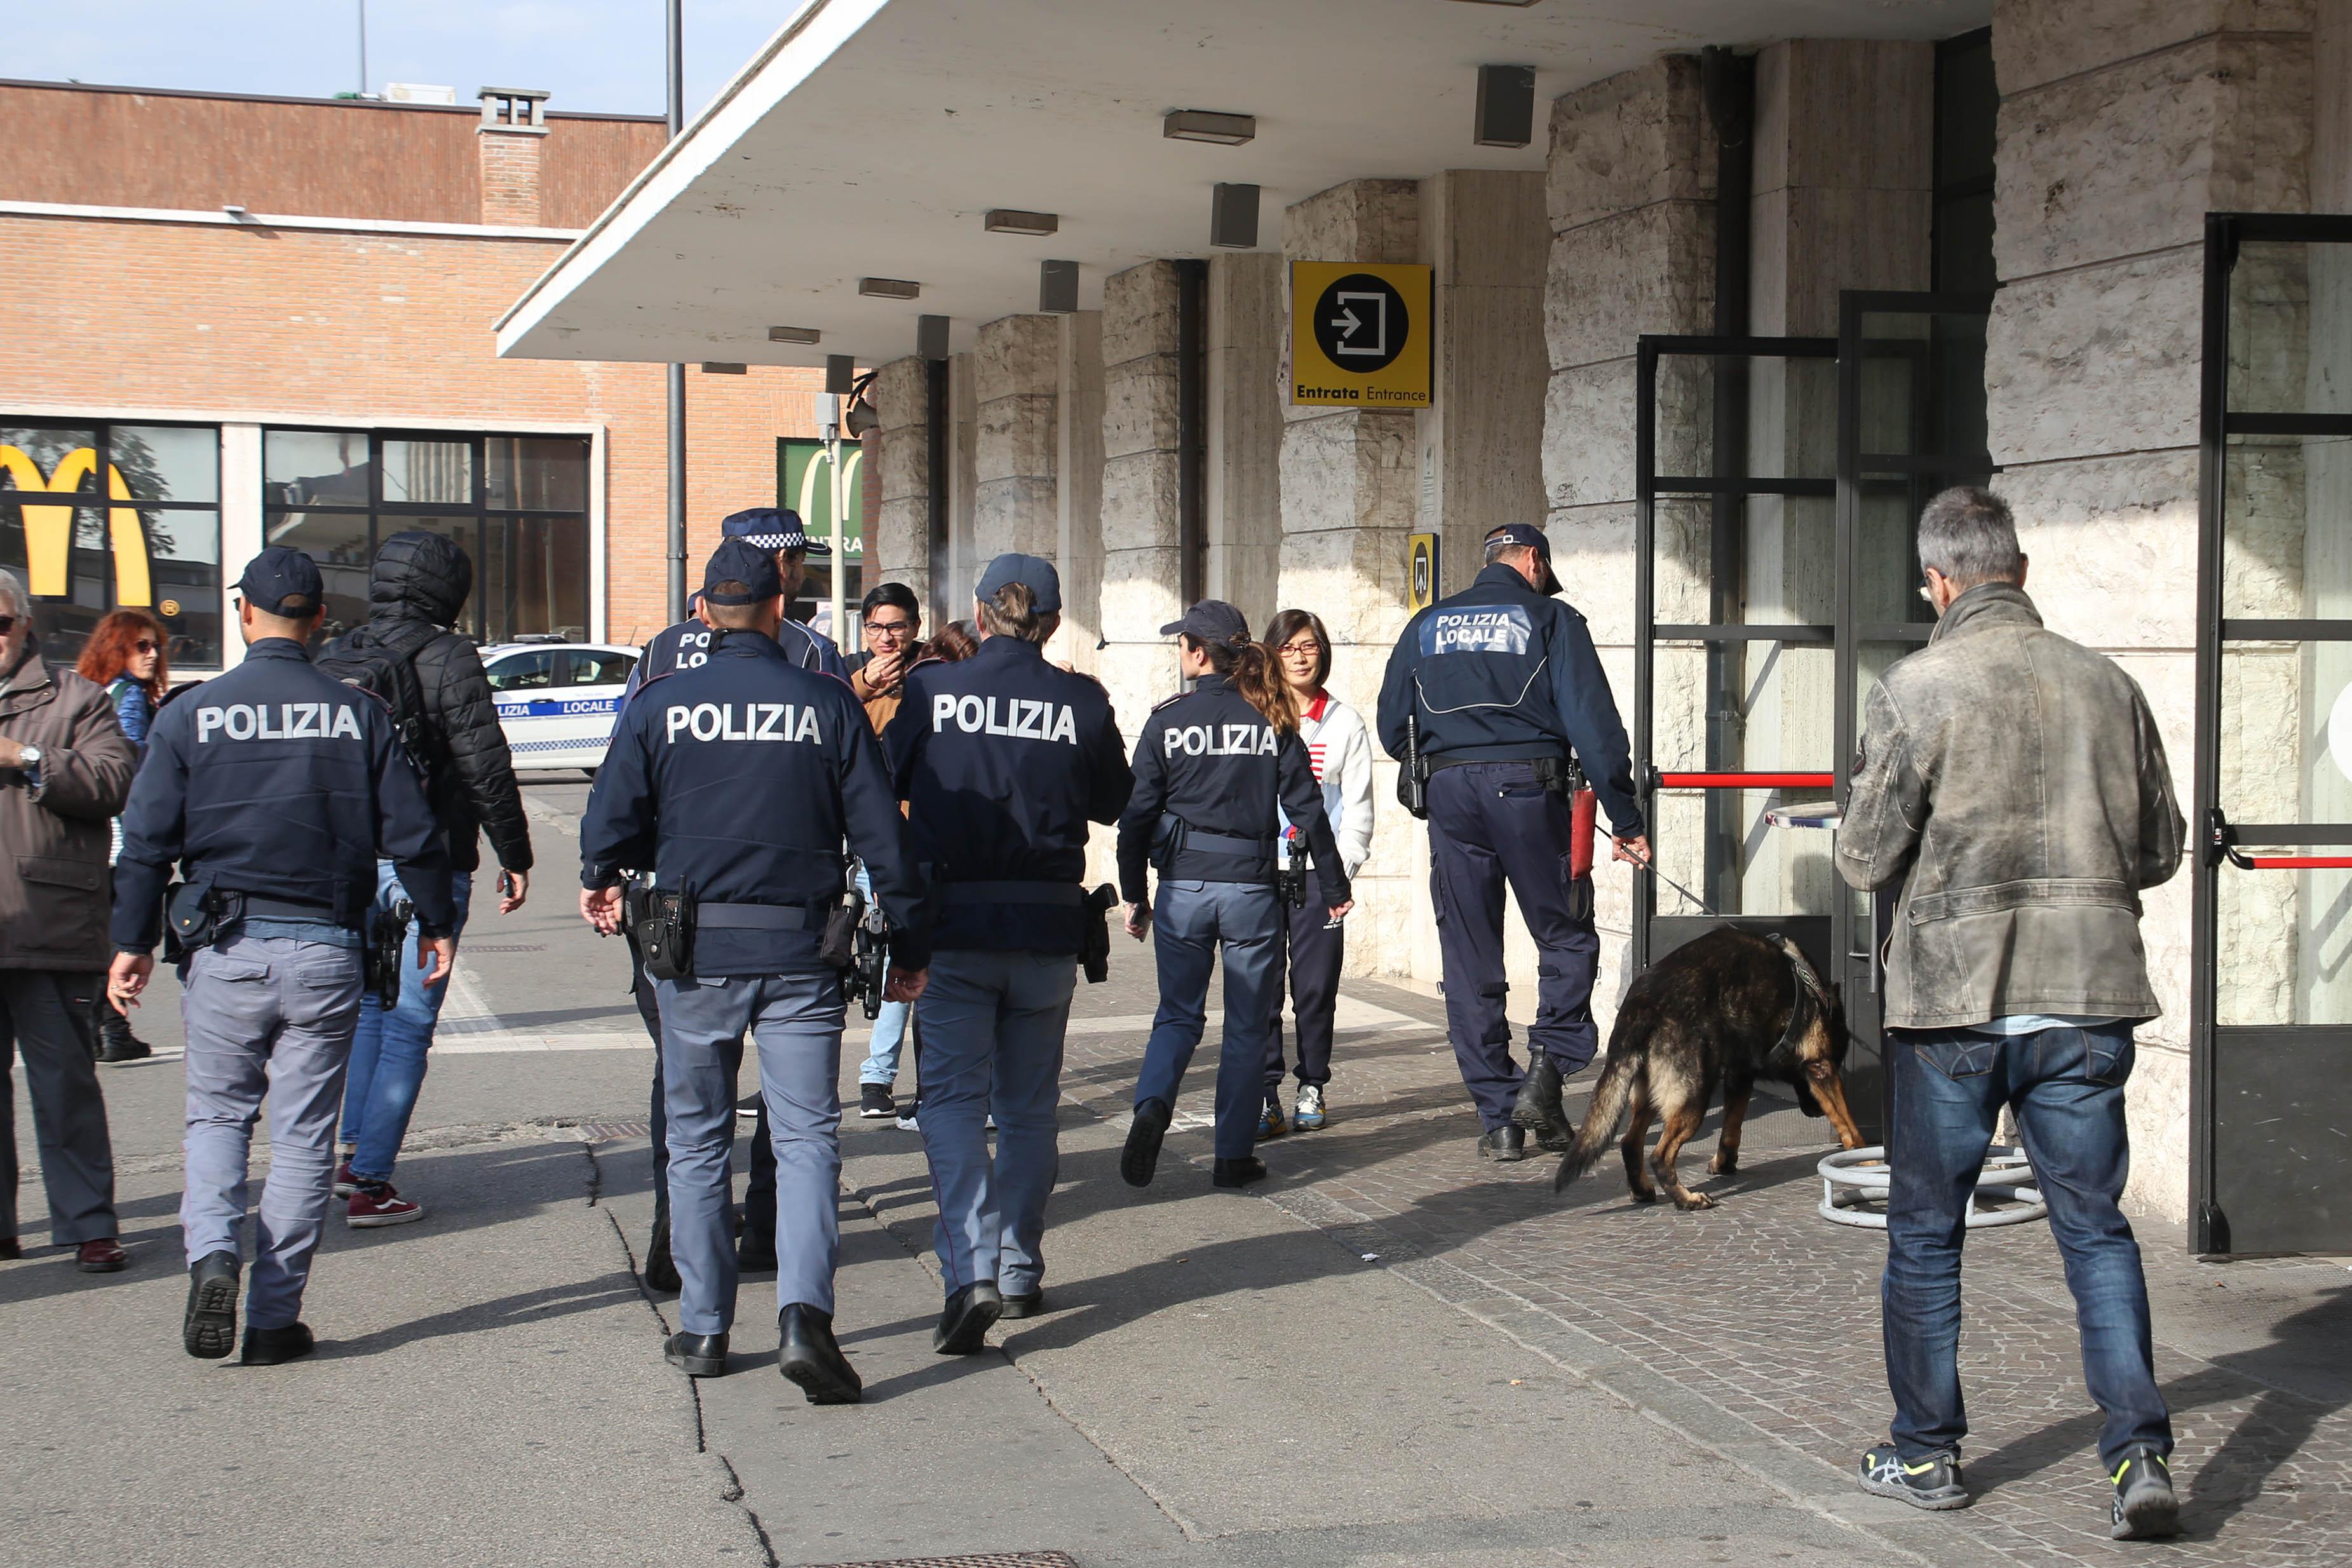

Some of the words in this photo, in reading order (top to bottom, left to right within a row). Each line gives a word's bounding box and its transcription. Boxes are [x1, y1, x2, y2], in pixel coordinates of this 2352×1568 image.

[1297, 385, 1359, 399] Entrata
[1367, 386, 1426, 401] Entrance
[1436, 613, 1510, 628] POLIZIA
[1435, 629, 1508, 646] LOCALE
[497, 705, 530, 716] LIZIA
[564, 700, 615, 713] LOCALE
[933, 694, 1078, 745] POLIZIA
[197, 703, 363, 743] POLIZIA
[666, 703, 822, 745] POLIZIA
[1164, 724, 1278, 759] POLIZIA
